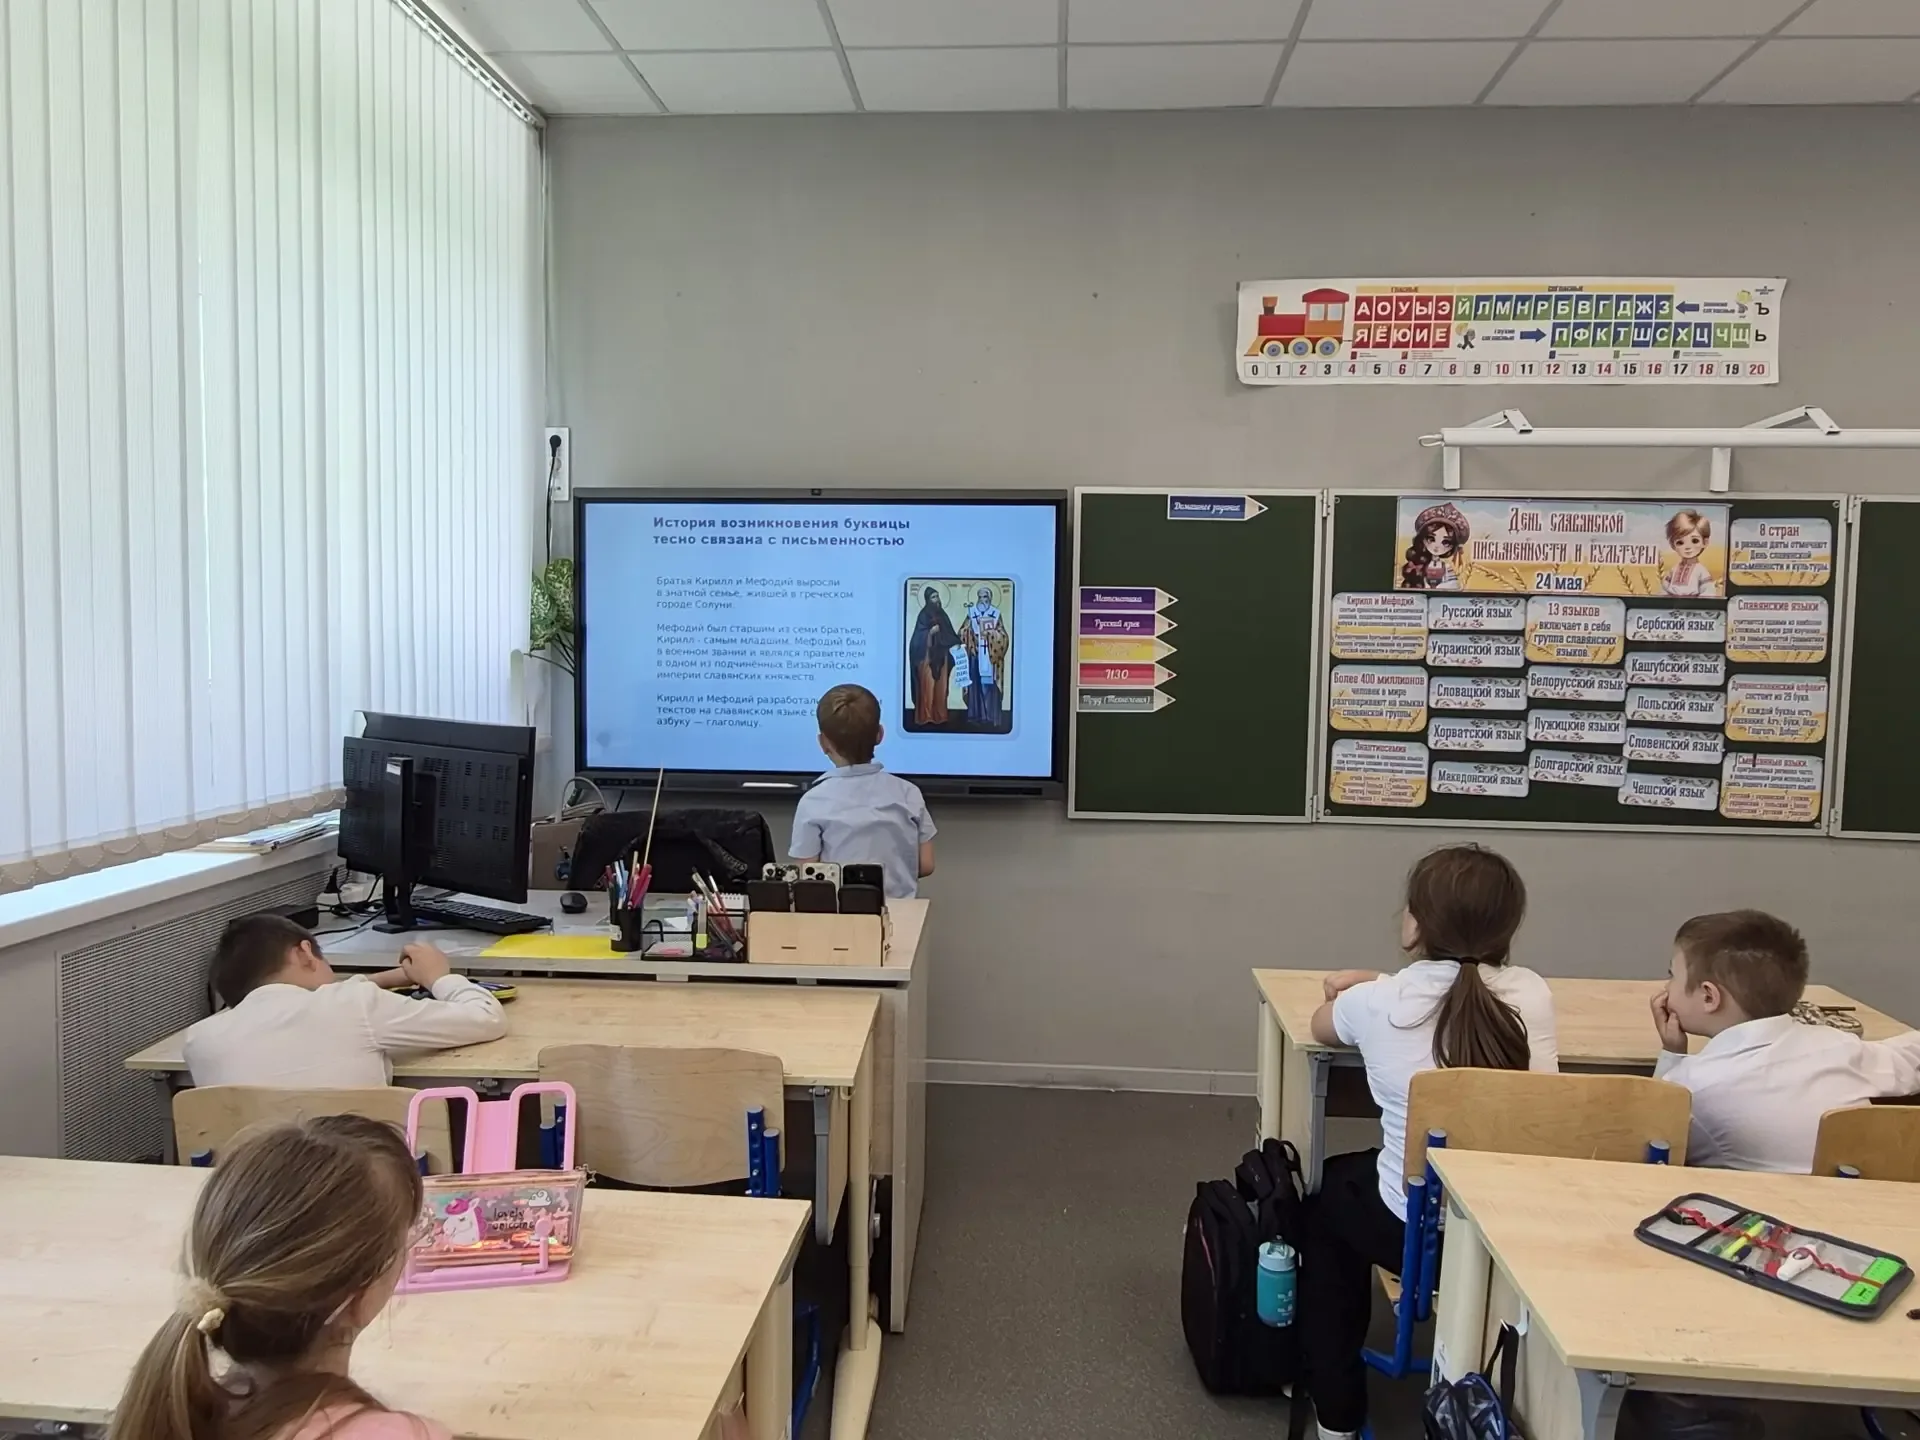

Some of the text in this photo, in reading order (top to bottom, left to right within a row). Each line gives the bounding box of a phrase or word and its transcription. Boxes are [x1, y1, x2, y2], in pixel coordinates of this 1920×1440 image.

[1252, 363, 1765, 376] 0 1 2 3 4 5 6 7 8 9 10 11 12 13 14 15 16 17 18 19 20
[654, 517, 910, 532] История возникновения буквицы
[1508, 507, 1624, 534] День славянской
[1760, 523, 1800, 540] 8 стран
[653, 536, 905, 546] тесно связана с письменностью
[1472, 541, 1656, 566] письменности и культуры
[1536, 572, 1582, 590] 24 мая
[1347, 596, 1414, 607] Кирилл Мефодий
[1442, 604, 1512, 619] Русский язык
[1548, 603, 1600, 617] 13 языков
[1539, 621, 1611, 632] включает в себя
[1637, 616, 1715, 633] Сербский язык
[1534, 634, 1616, 645] группа славянских
[1431, 641, 1492, 657] Украинский
[1495, 644, 1521, 656] язык
[1556, 648, 1589, 657] языков.
[1632, 658, 1719, 676] Кашубский язык
[1334, 672, 1425, 686] Более 400 миллионов
[1531, 673, 1624, 691] Белорусский язык
[1437, 684, 1521, 700] Словацкий язык
[1637, 696, 1715, 712] Польский язык
[1434, 724, 1522, 741] Хорватский язык
[1534, 717, 1620, 733] Лужицкие языки
[1629, 735, 1720, 752] Словенский язык
[1534, 756, 1623, 776] Болгарский язык
[1438, 770, 1523, 785] Македонский язык
[1633, 781, 1706, 798] Чешский язык
[494, 1208, 524, 1221] lovely
